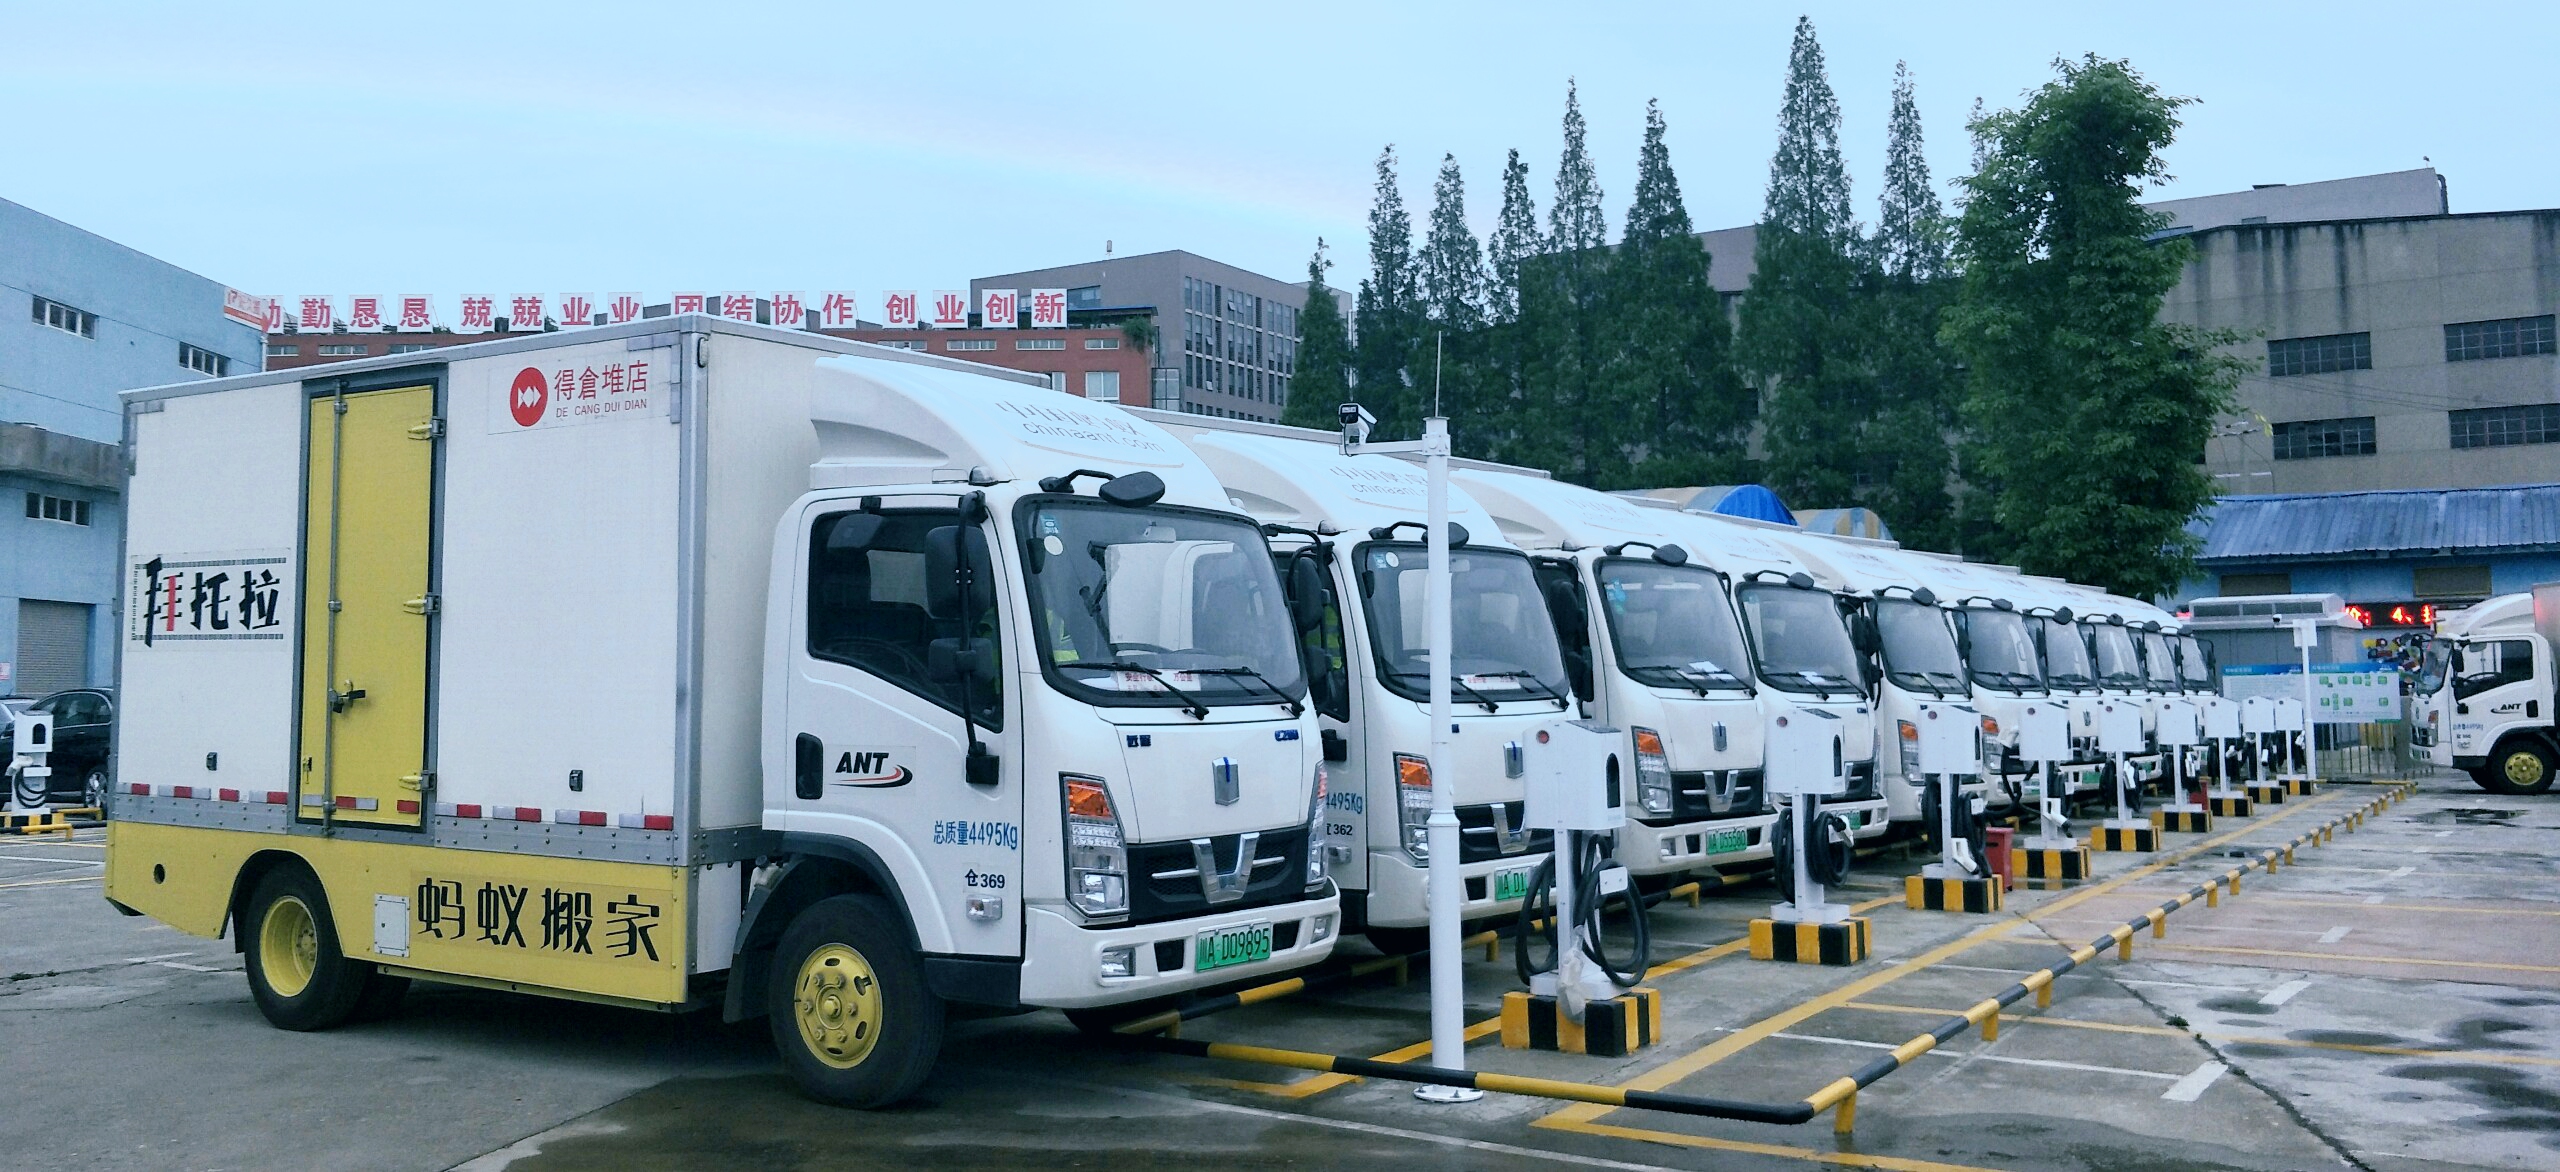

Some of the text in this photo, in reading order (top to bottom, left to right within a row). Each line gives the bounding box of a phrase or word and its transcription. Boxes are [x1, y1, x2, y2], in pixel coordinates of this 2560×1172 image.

[461, 296, 640, 327] 兢兢业业
[674, 293, 854, 324] 团结协作
[886, 293, 1066, 324] 创业创新
[554, 360, 648, 401] 得倉堆店
[556, 398, 647, 418] DE CANG DUI DIAN
[1023, 421, 1166, 453] chinaant.com
[1352, 482, 1432, 497] chinaant.c
[143, 557, 280, 648] 拜托拉
[2500, 703, 2521, 711] ANT
[835, 751, 889, 774] ANT
[933, 820, 1018, 849] 总质量4495Kg
[965, 868, 1006, 889] 仓369
[417, 877, 660, 962] 蚂蚁搬家
